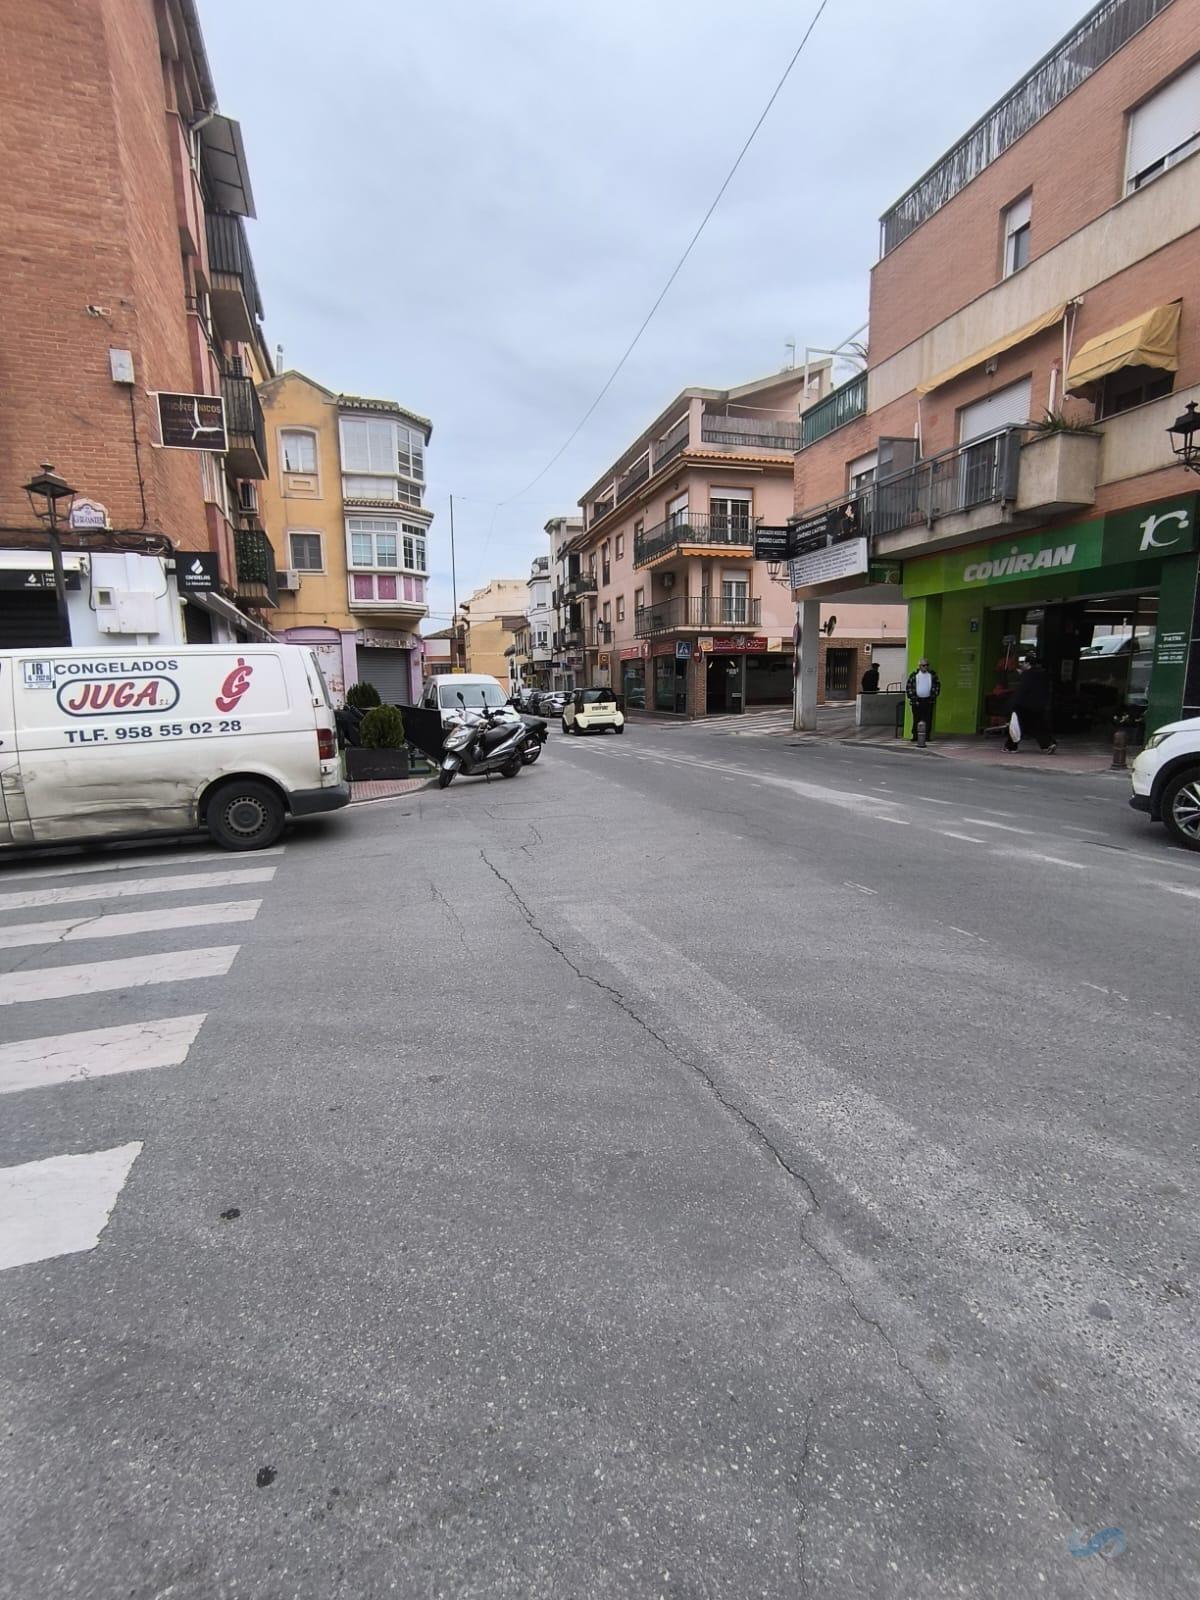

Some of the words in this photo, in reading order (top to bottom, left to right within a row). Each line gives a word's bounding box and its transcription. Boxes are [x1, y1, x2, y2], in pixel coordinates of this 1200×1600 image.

[55, 660, 179, 675] CONGELADOS
[69, 681, 159, 710] JUGA
[64, 728, 108, 743] TLF.
[115, 726, 153, 740] 958
[159, 723, 183, 737] 55
[189, 721, 213, 735] 02
[219, 719, 242, 732] 28
